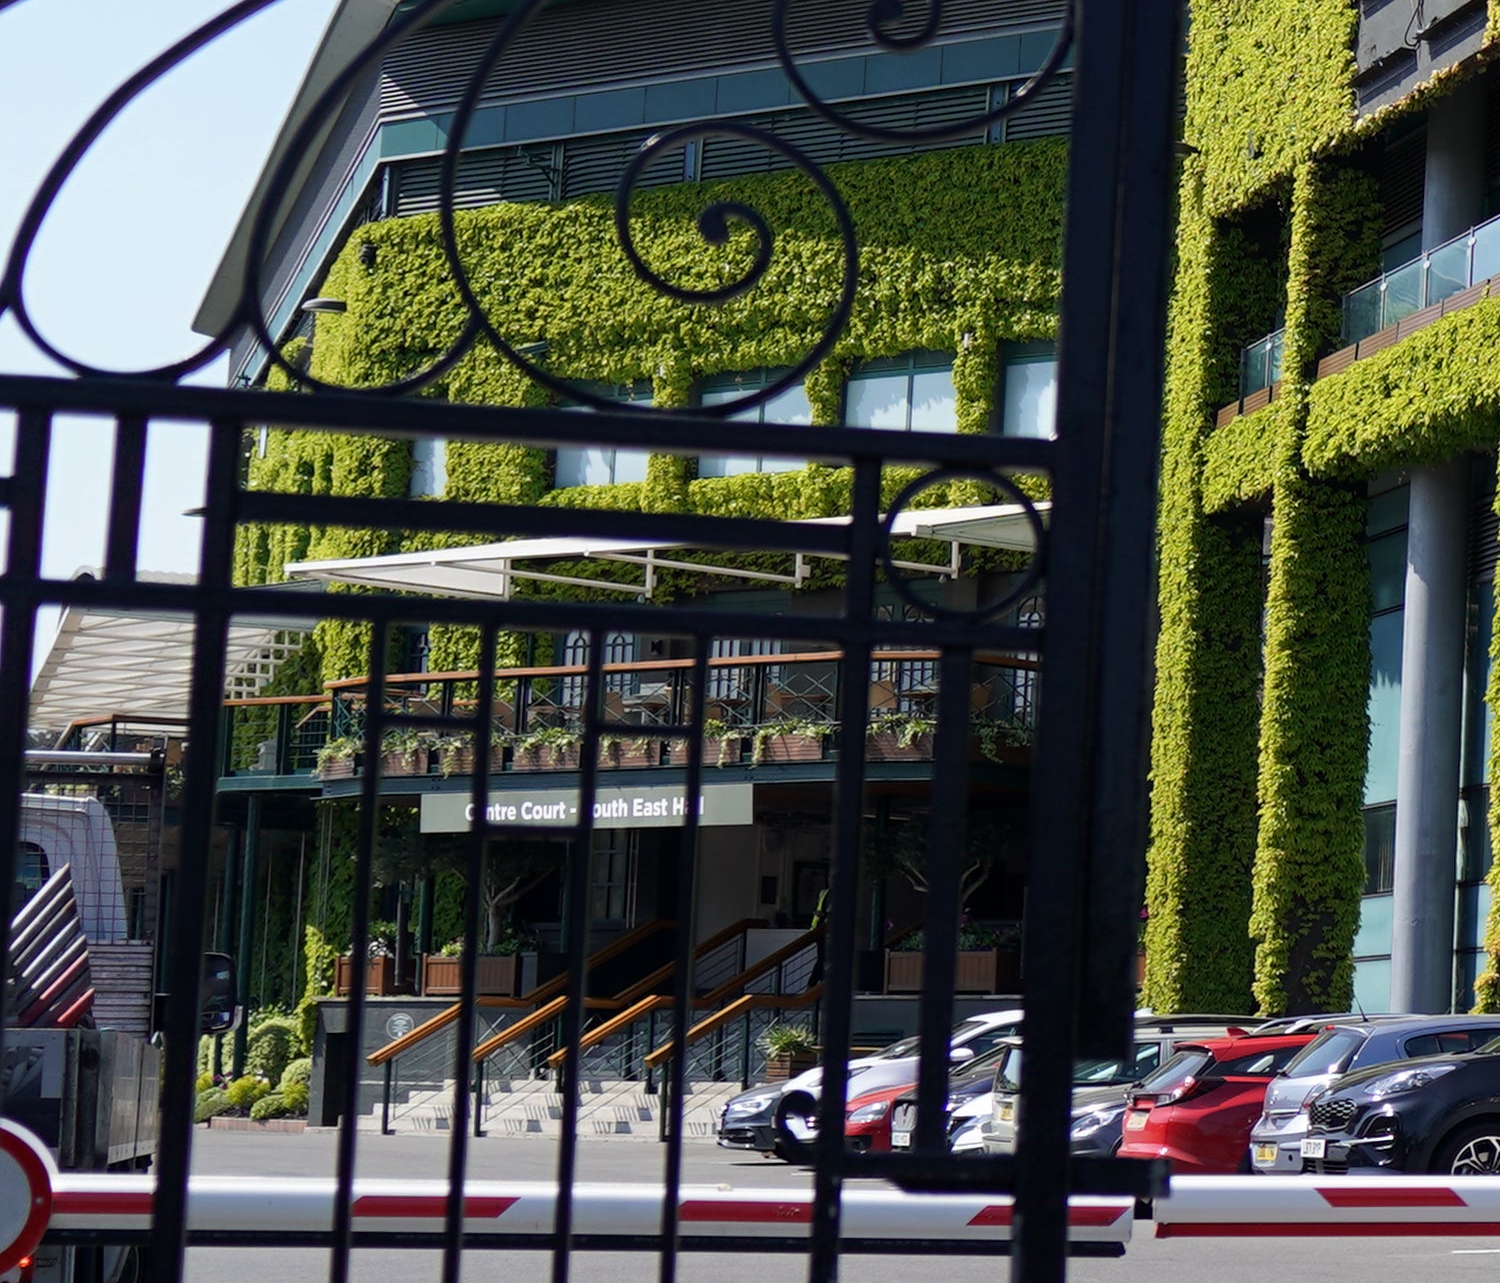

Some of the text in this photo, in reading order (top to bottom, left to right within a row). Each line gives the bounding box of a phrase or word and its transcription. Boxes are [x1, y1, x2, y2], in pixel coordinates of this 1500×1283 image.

[465, 802, 516, 821] Cntre
[522, 801, 566, 821] Court
[592, 798, 629, 818] outh
[632, 797, 668, 817] East
[672, 796, 704, 815] Hl
